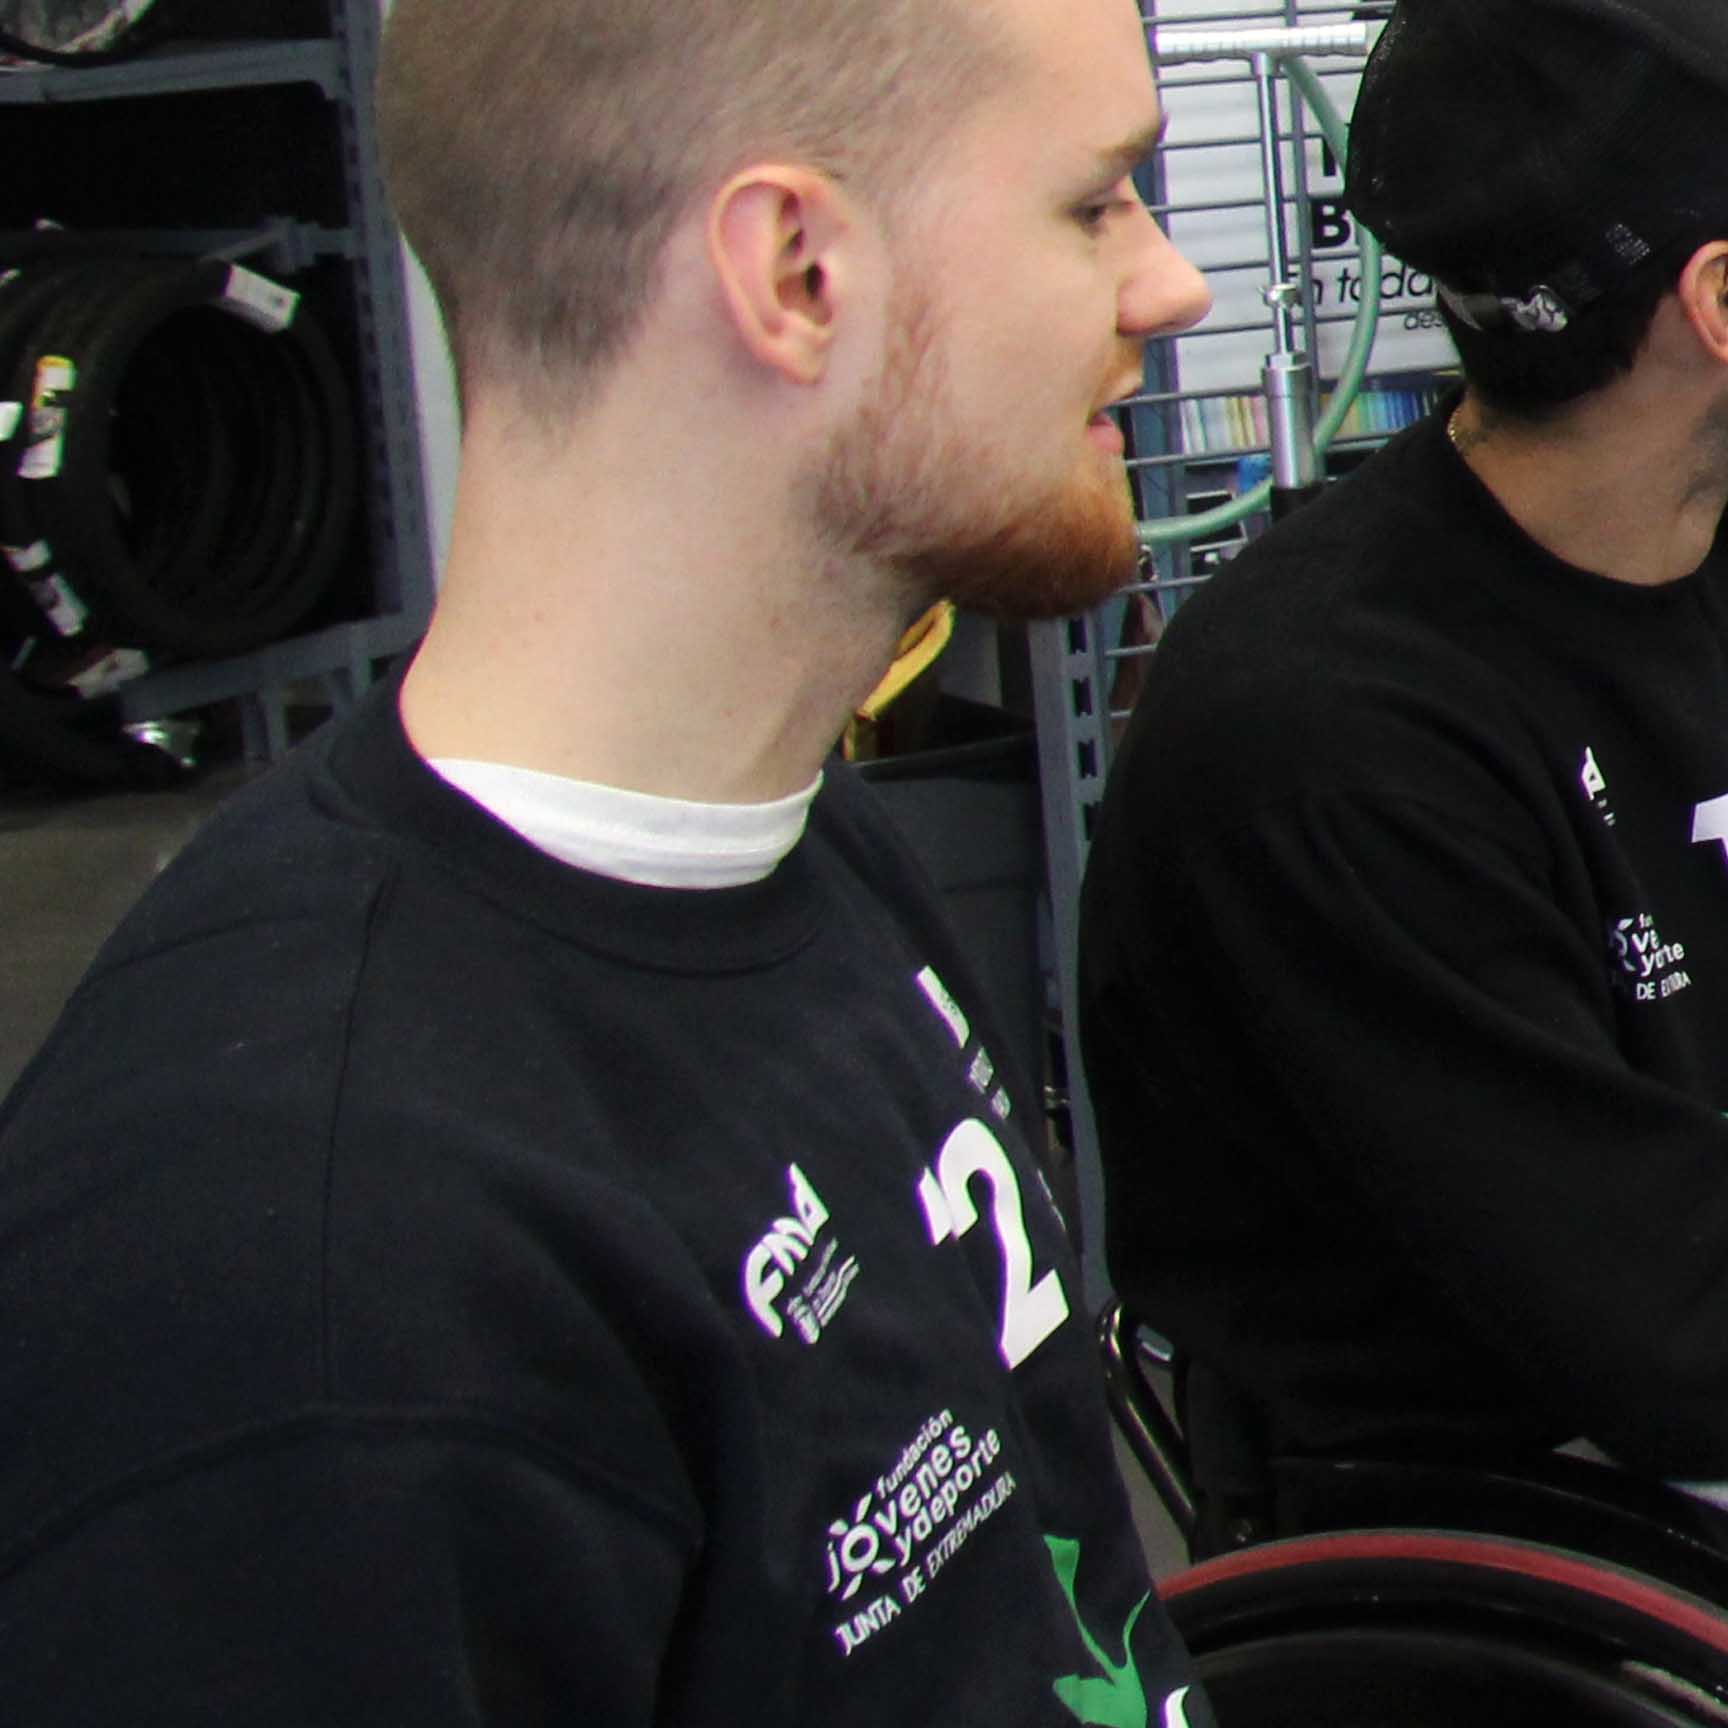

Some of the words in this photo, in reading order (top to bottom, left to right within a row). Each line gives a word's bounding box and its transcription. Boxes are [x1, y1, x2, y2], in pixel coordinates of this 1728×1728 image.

[875, 1408, 954, 1499] fundación
[834, 1594, 902, 1657] JUNTA
[902, 1566, 926, 1604] DE
[925, 1471, 1018, 1579] EXTREMADURA
